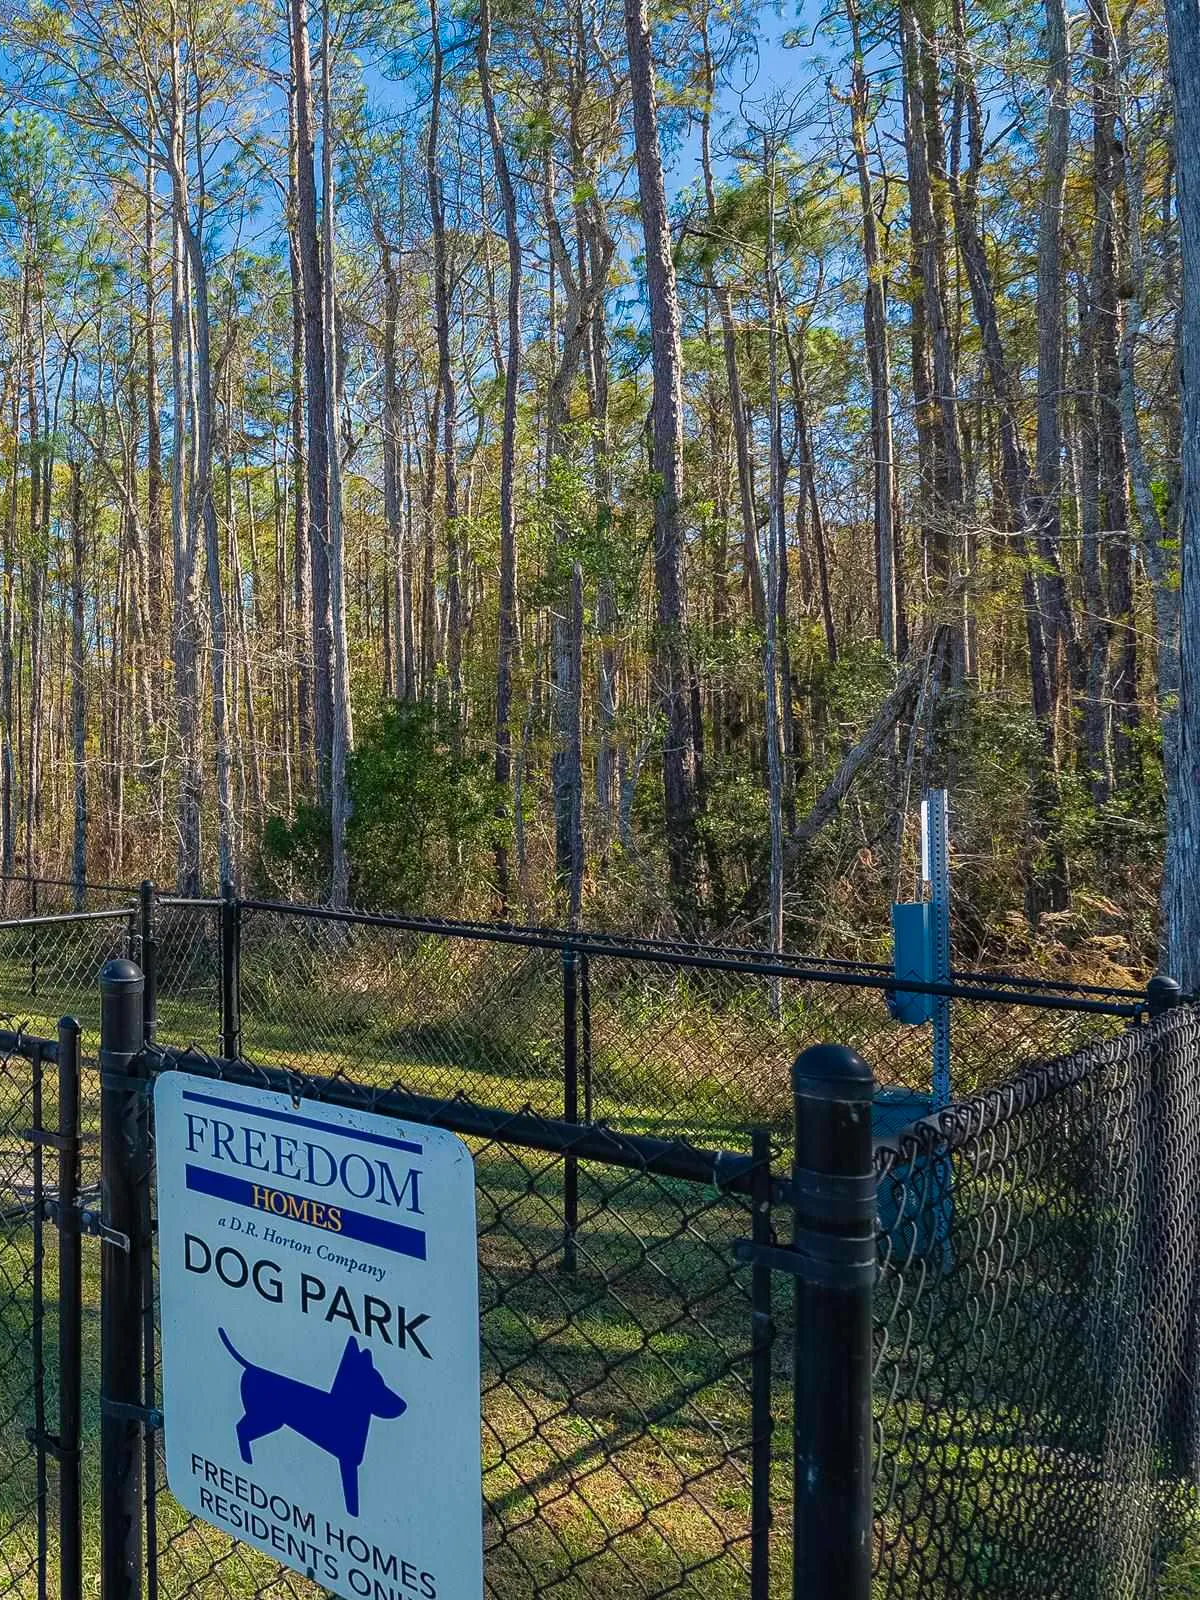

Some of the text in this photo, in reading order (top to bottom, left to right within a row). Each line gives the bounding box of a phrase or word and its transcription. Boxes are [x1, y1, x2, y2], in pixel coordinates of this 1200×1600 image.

[184, 1112, 425, 1215] FREEDOM
[252, 1184, 344, 1233] HOMES
[184, 1232, 434, 1361] DOG PARK
[217, 1216, 387, 1282] a D.R. Horton Company
[191, 1453, 437, 1600] FREEDOM HOMES
[199, 1486, 414, 1600] RESIDENTS ON
